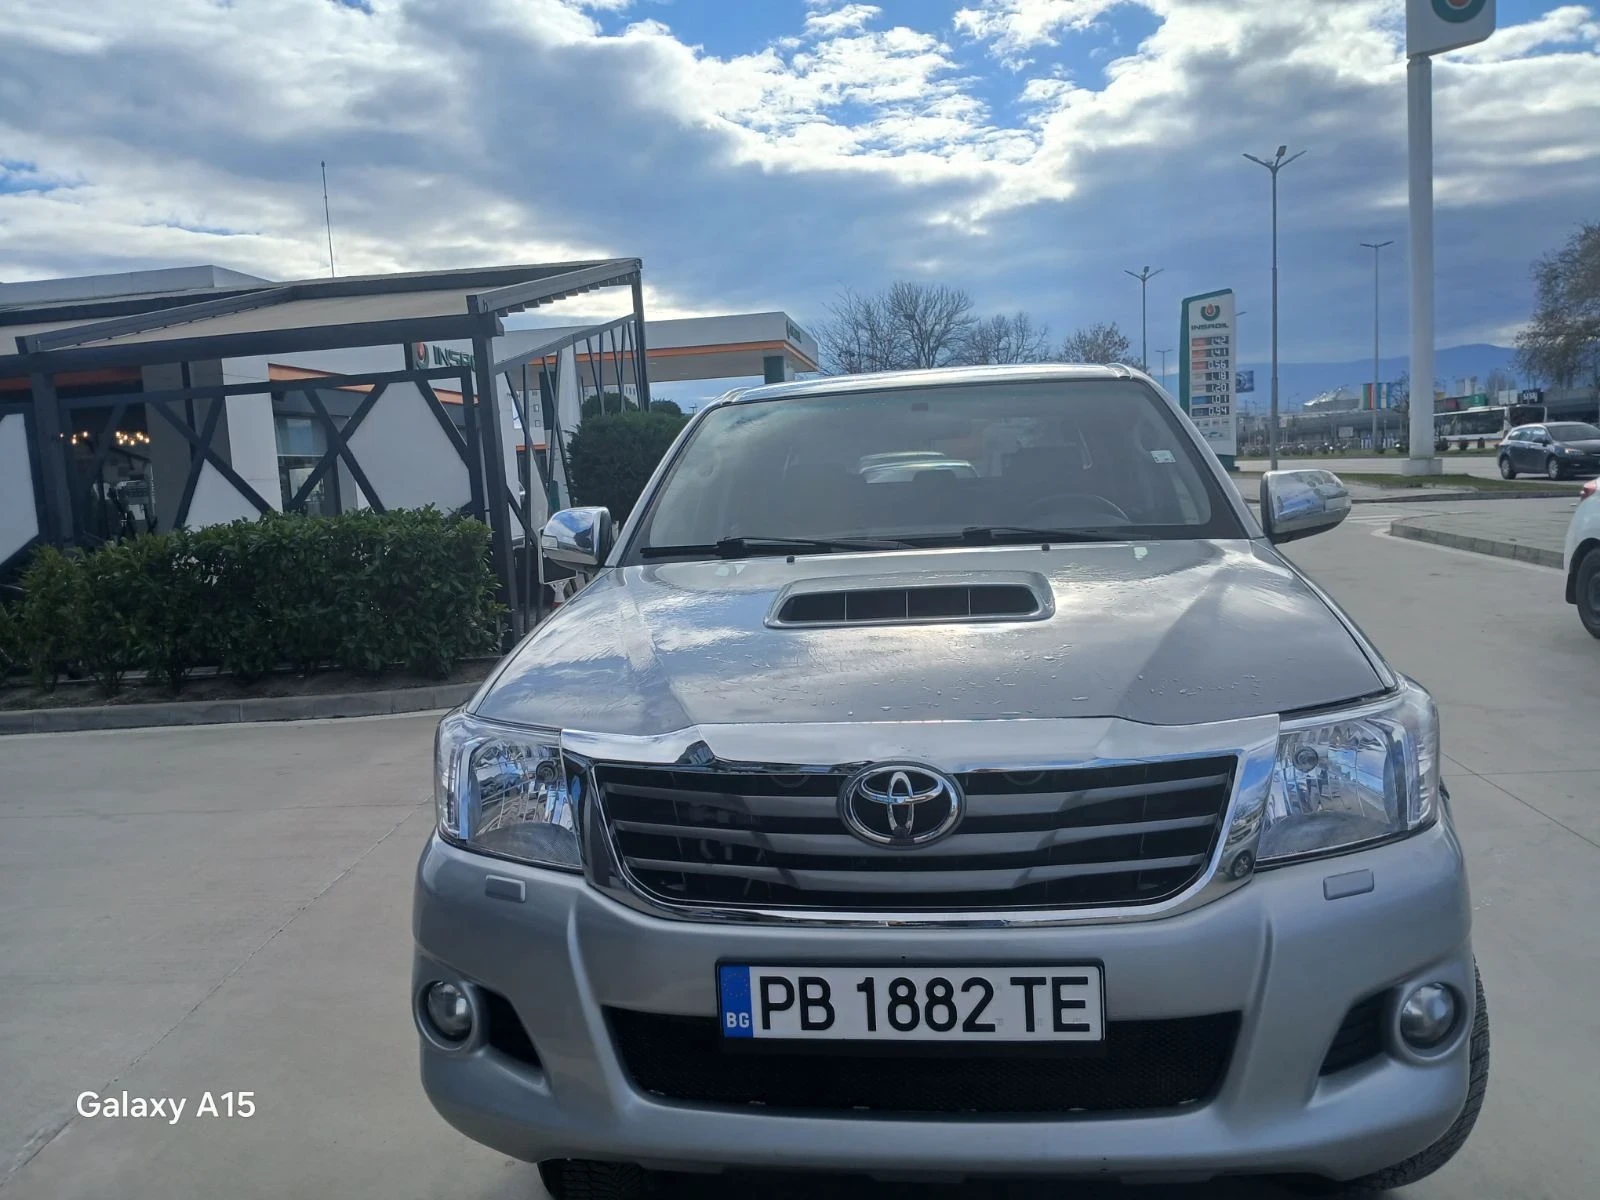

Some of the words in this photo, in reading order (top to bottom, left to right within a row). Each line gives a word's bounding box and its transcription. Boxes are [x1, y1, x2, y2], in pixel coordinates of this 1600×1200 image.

[726, 1011, 750, 1028] BG
[759, 976, 835, 1030] PB
[856, 976, 996, 1032] 1882
[1009, 976, 1091, 1032] TE
